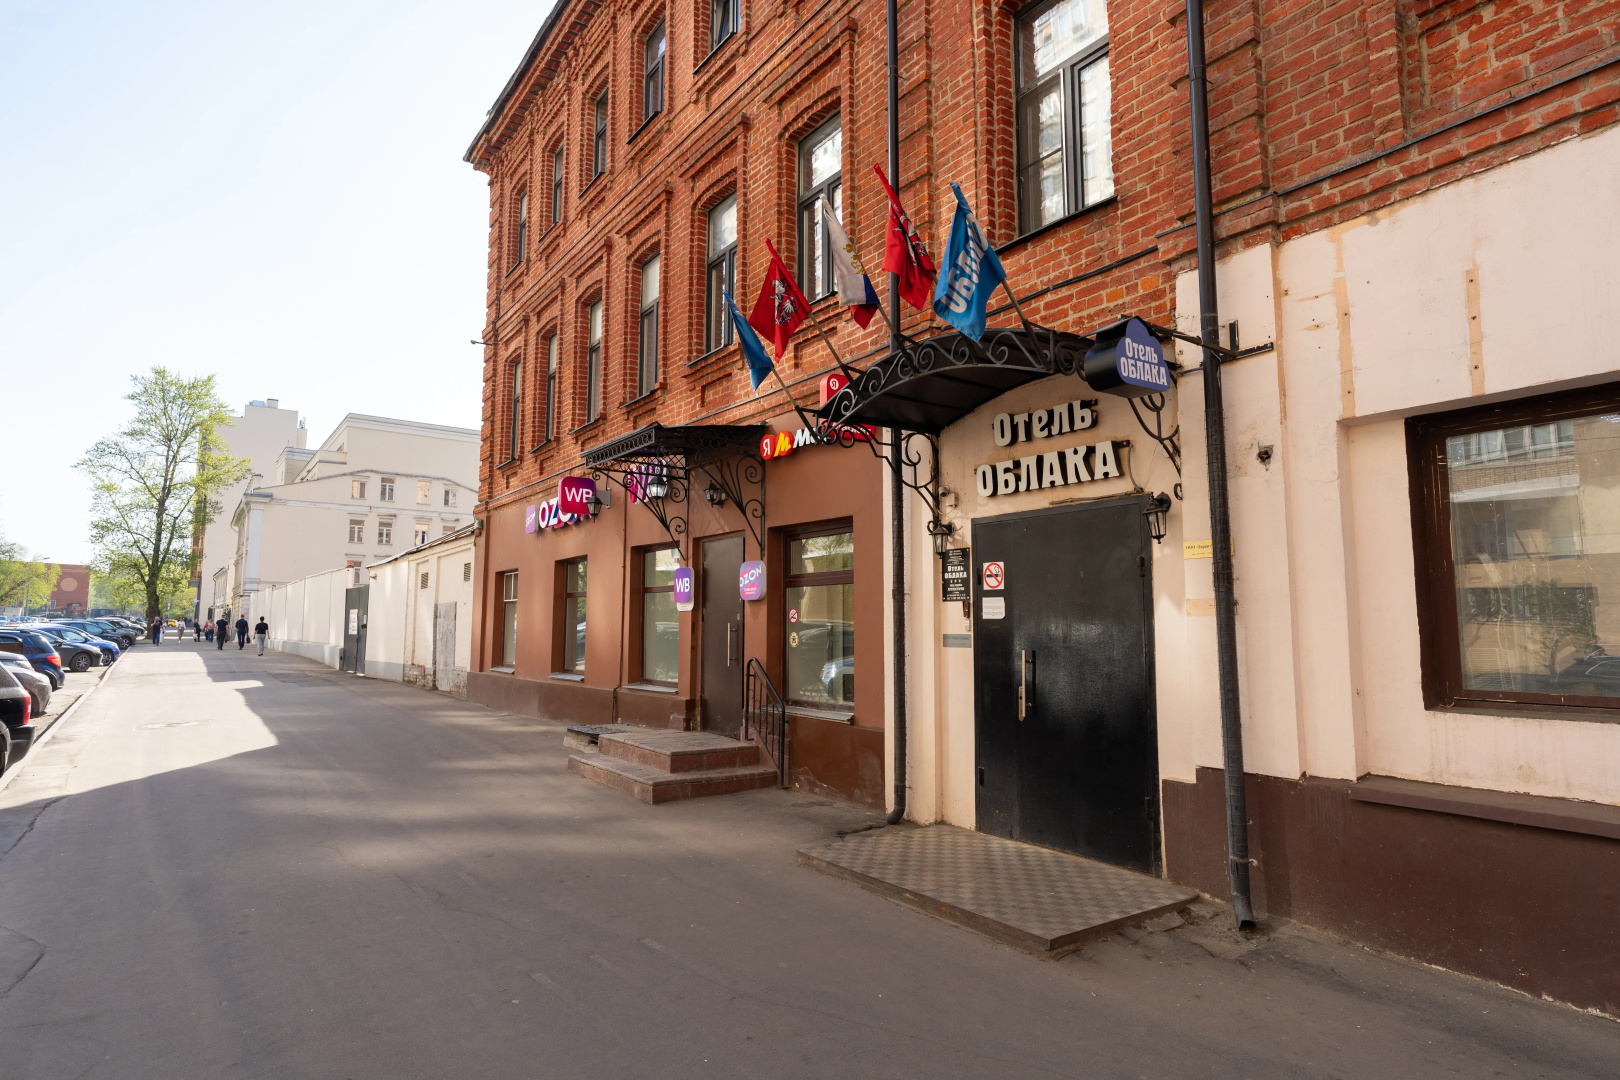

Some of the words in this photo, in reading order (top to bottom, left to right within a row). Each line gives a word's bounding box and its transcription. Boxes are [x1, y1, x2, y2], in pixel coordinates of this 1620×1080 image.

[1125, 337, 1158, 363] Отель
[1120, 357, 1167, 386] ОБЛАКА
[994, 400, 1092, 447] Отель
[976, 440, 1119, 497] ОБЛАКА
[565, 487, 593, 503] WB
[675, 577, 691, 593] WB
[740, 566, 761, 588] OZON
